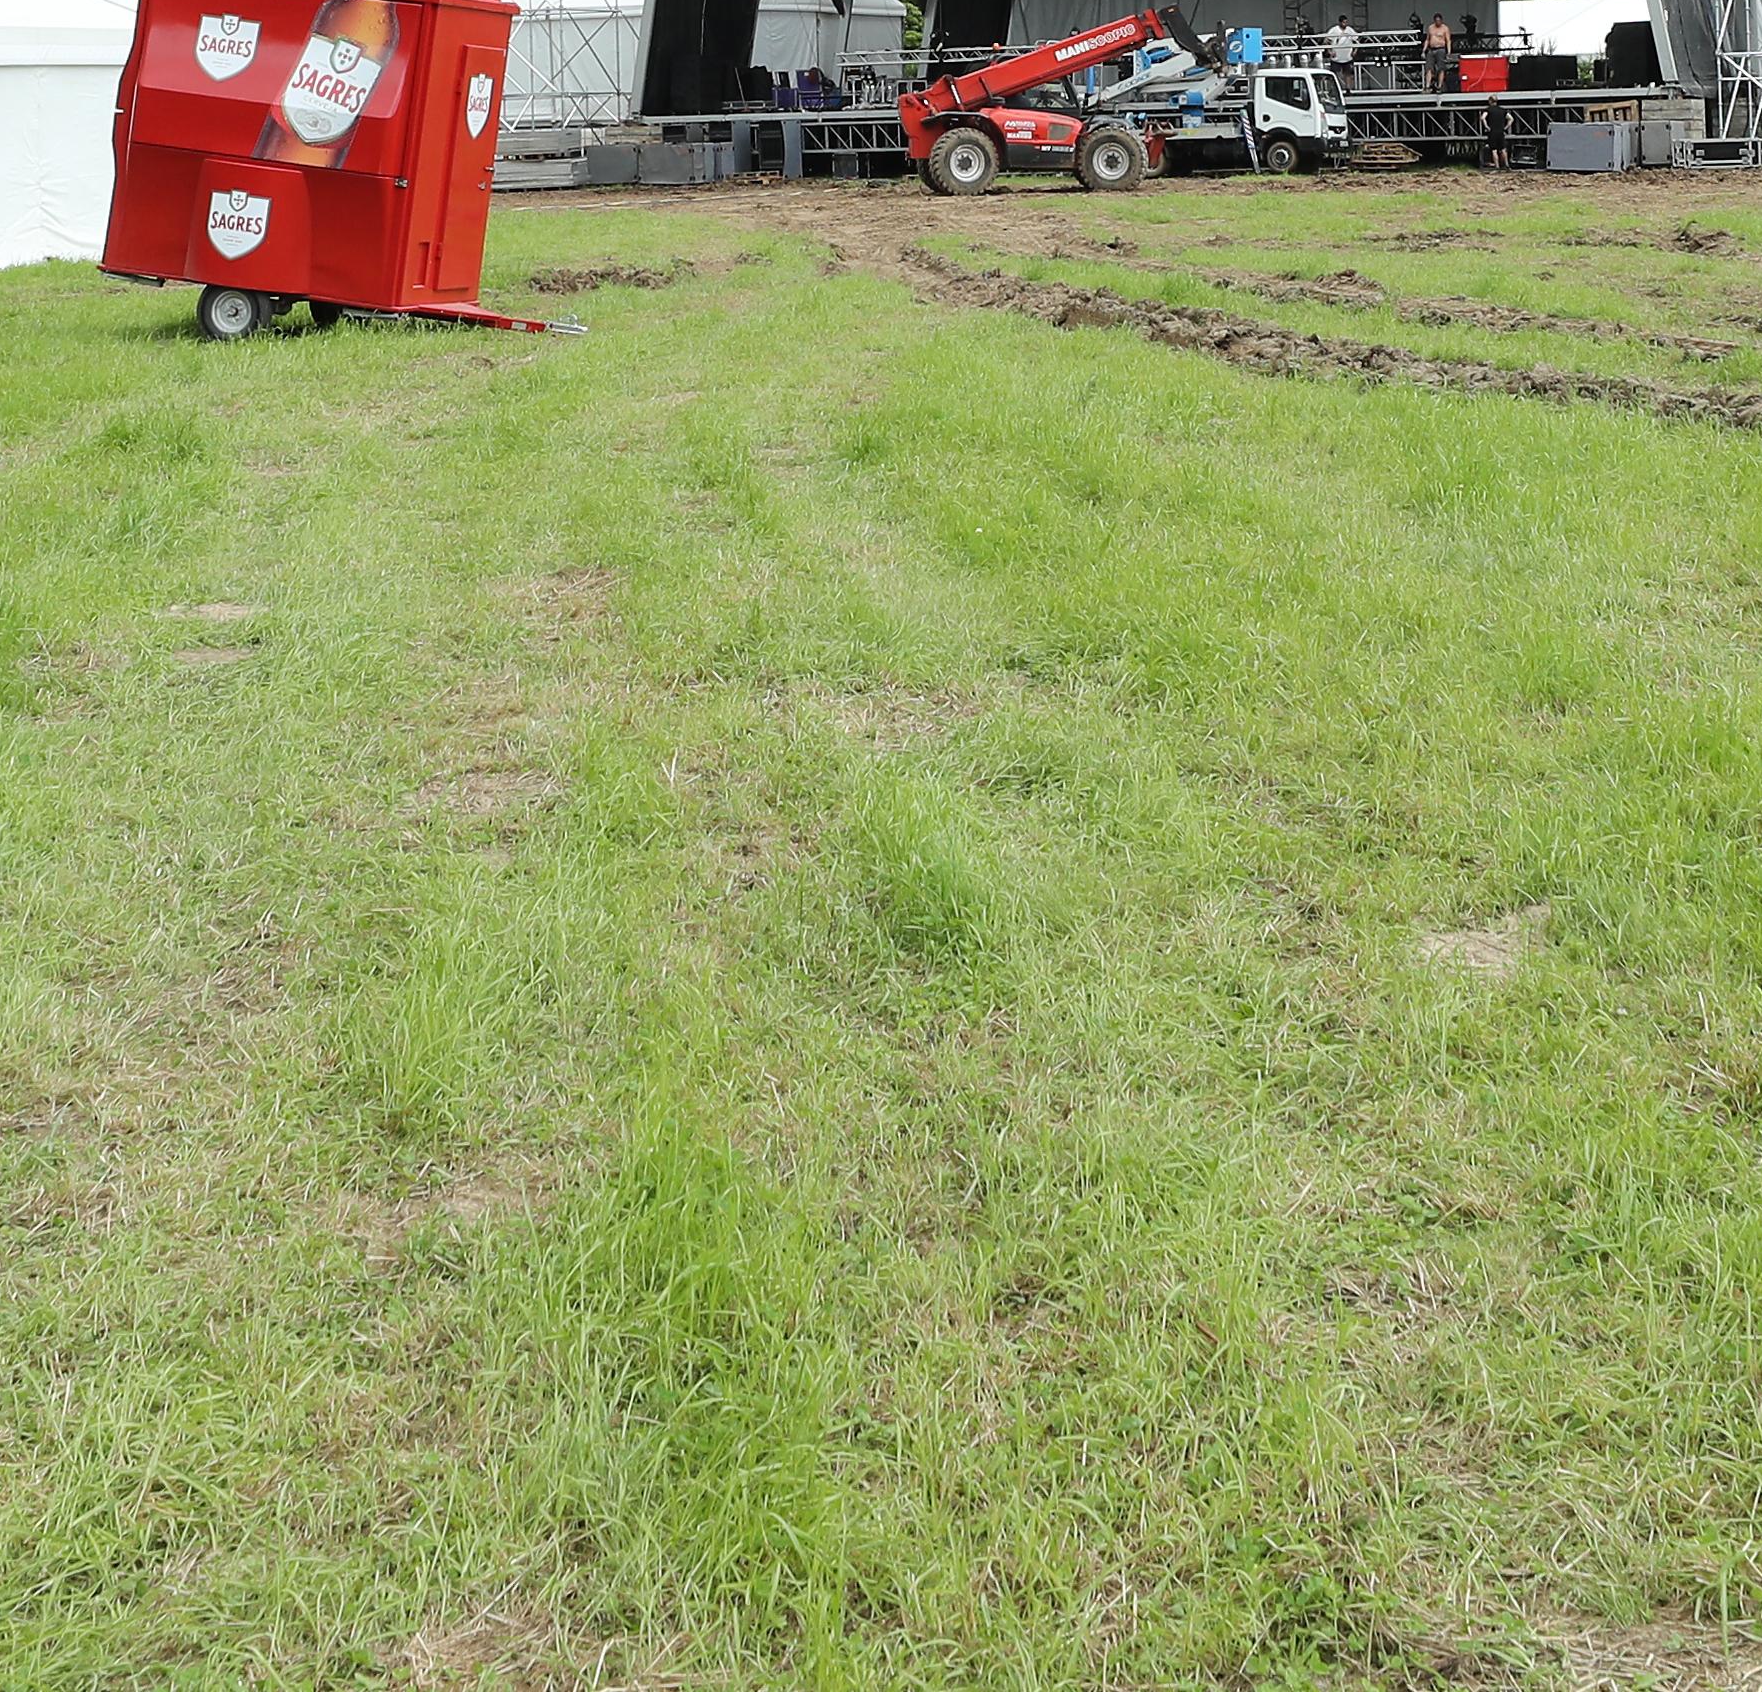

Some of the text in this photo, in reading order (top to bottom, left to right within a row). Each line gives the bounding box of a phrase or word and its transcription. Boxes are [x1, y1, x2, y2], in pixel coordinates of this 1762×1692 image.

[199, 34, 253, 58] SAGRES
[1054, 23, 1136, 62] MANISCOPIC
[291, 63, 367, 114] SAGRES
[210, 211, 263, 235] SAGRES
